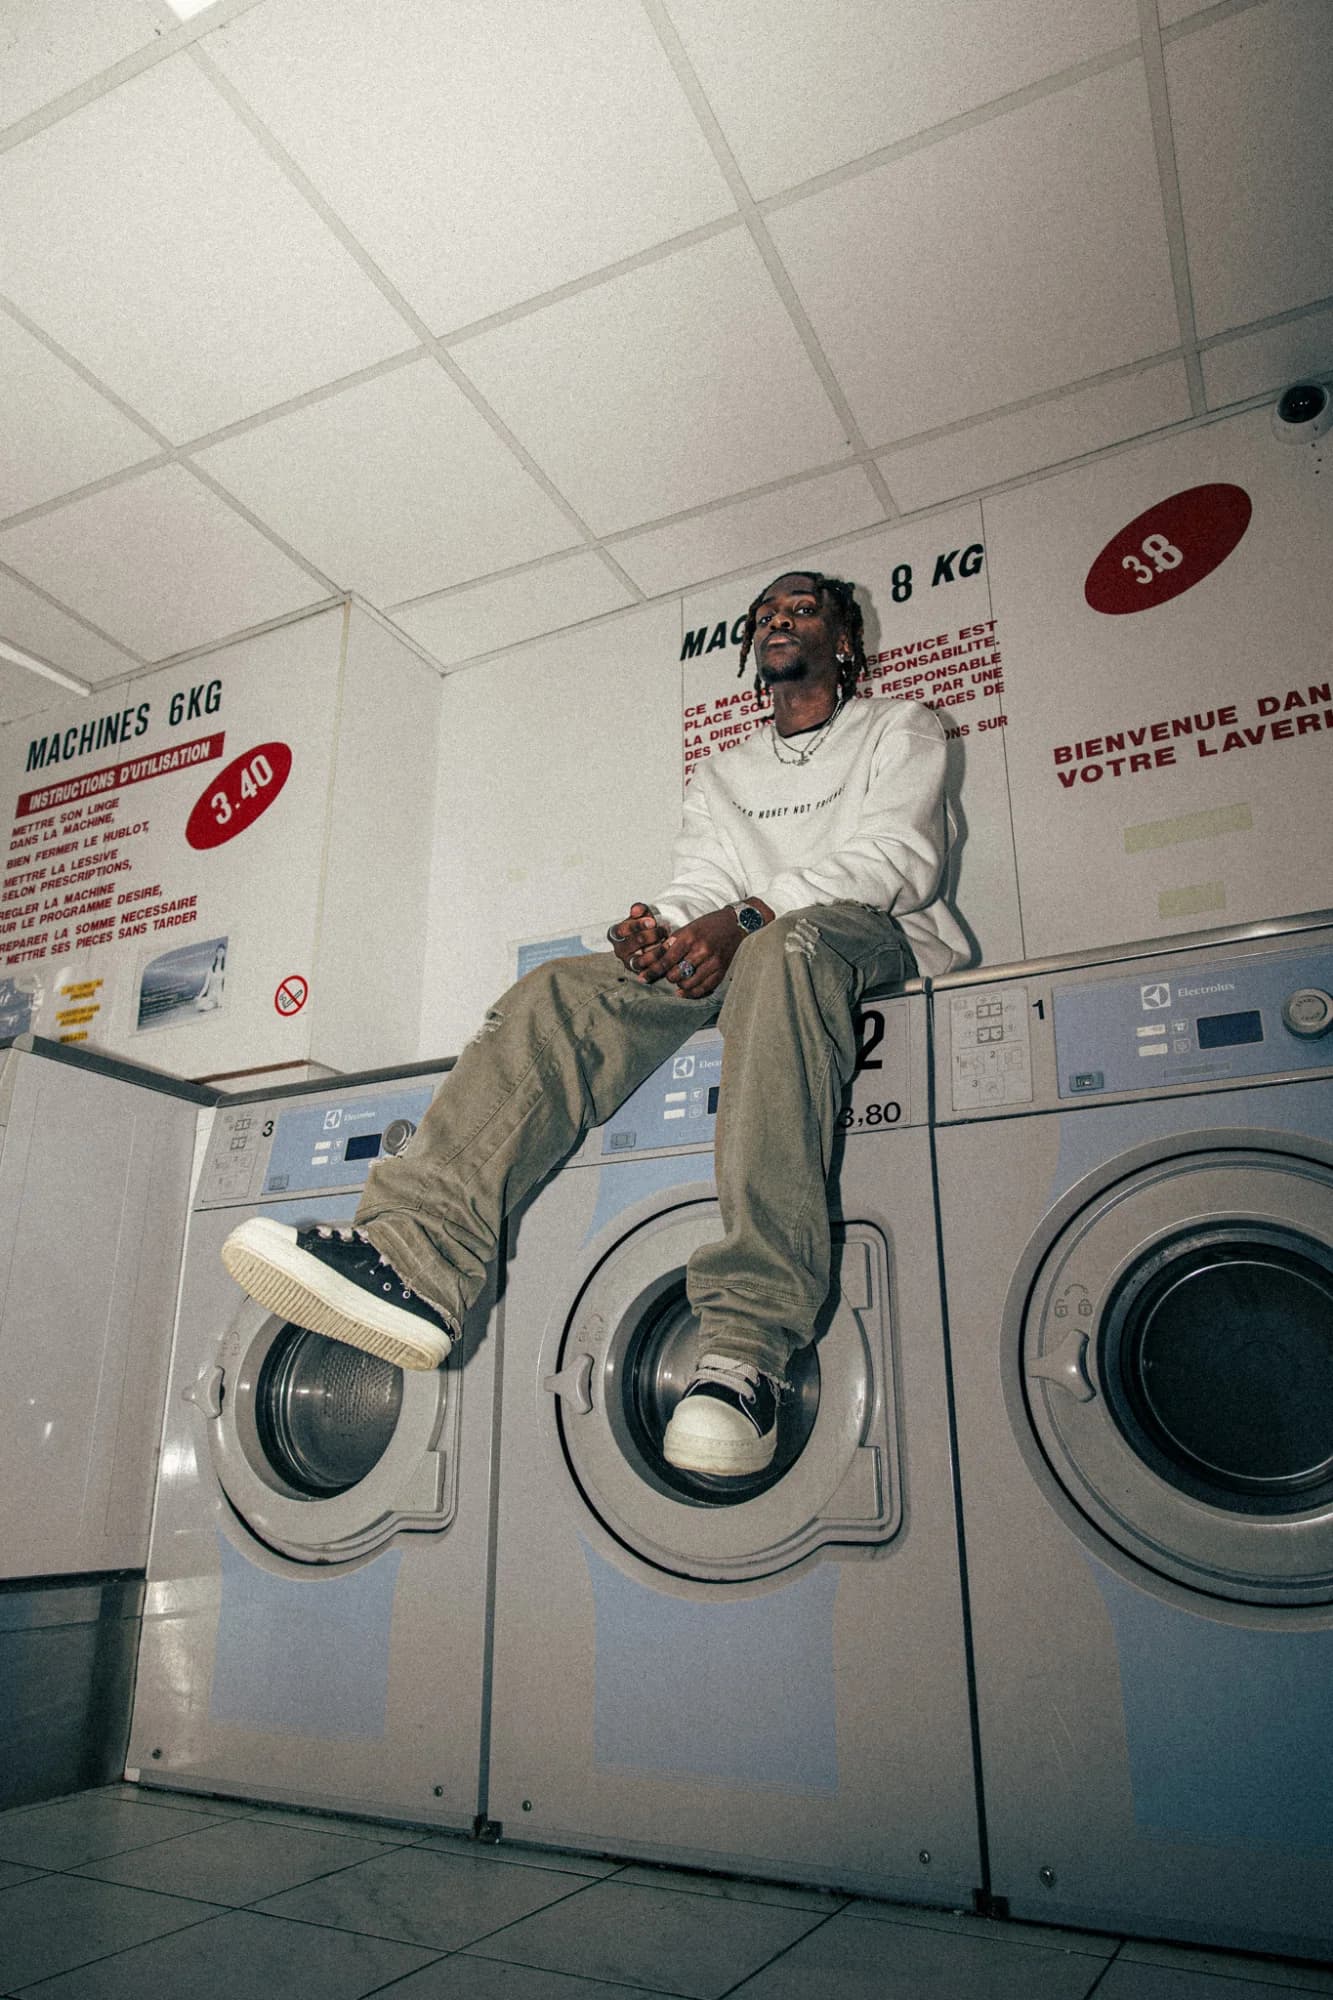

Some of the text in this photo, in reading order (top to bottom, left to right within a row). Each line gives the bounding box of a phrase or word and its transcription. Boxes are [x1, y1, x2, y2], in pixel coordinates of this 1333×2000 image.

[891, 564, 913, 603] 8
[931, 543, 984, 588] KG
[684, 703, 707, 718] CE
[866, 633, 949, 666] SERVICE
[959, 620, 998, 641] EST
[983, 682, 1005, 697] DE
[684, 735, 703, 748] LA
[881, 652, 1002, 694] RESPONSABLE
[684, 746, 712, 761] DES
[932, 677, 964, 695] PAR
[971, 667, 1004, 685] UNE
[684, 710, 733, 732] PLACE
[25, 679, 223, 772] MACHINES 6KG
[978, 715, 1008, 732] SUR
[1053, 682, 1332, 766] BIENVENUE DAN
[28, 741, 211, 811] INSTRUCTIONS D'UTILISATION
[1057, 746, 1178, 789] VOTRE
[211, 754, 274, 825] 3.40
[10, 813, 115, 850] DANS LA MACHINE,
[12, 797, 120, 837] METTRE SON LINGE
[3, 848, 119, 888] METTRE LA LESSIVE
[6, 854, 31, 869] BIEN
[35, 841, 79, 861] FERMER
[84, 835, 98, 848] LE
[1, 858, 133, 902] SELON PRESCRIPTIONS,
[44, 897, 58, 910] LA
[63, 882, 116, 904] MACHINE
[21, 917, 36, 929] LE
[39, 897, 112, 925] PROGRAMME
[117, 884, 163, 905] DESIRE,
[54, 928, 68, 941] LA
[75, 916, 116, 935] SOMME
[120, 895, 197, 924] NECESSAIRE
[6, 910, 198, 966] METTRE SES PIECES SANS TARDER
[1031, 999, 1045, 1020] 1
[1177, 982, 1236, 998] Electrolux
[856, 1009, 885, 1070] 2
[262, 1120, 275, 1137] 3
[840, 1101, 902, 1128] 3,80
